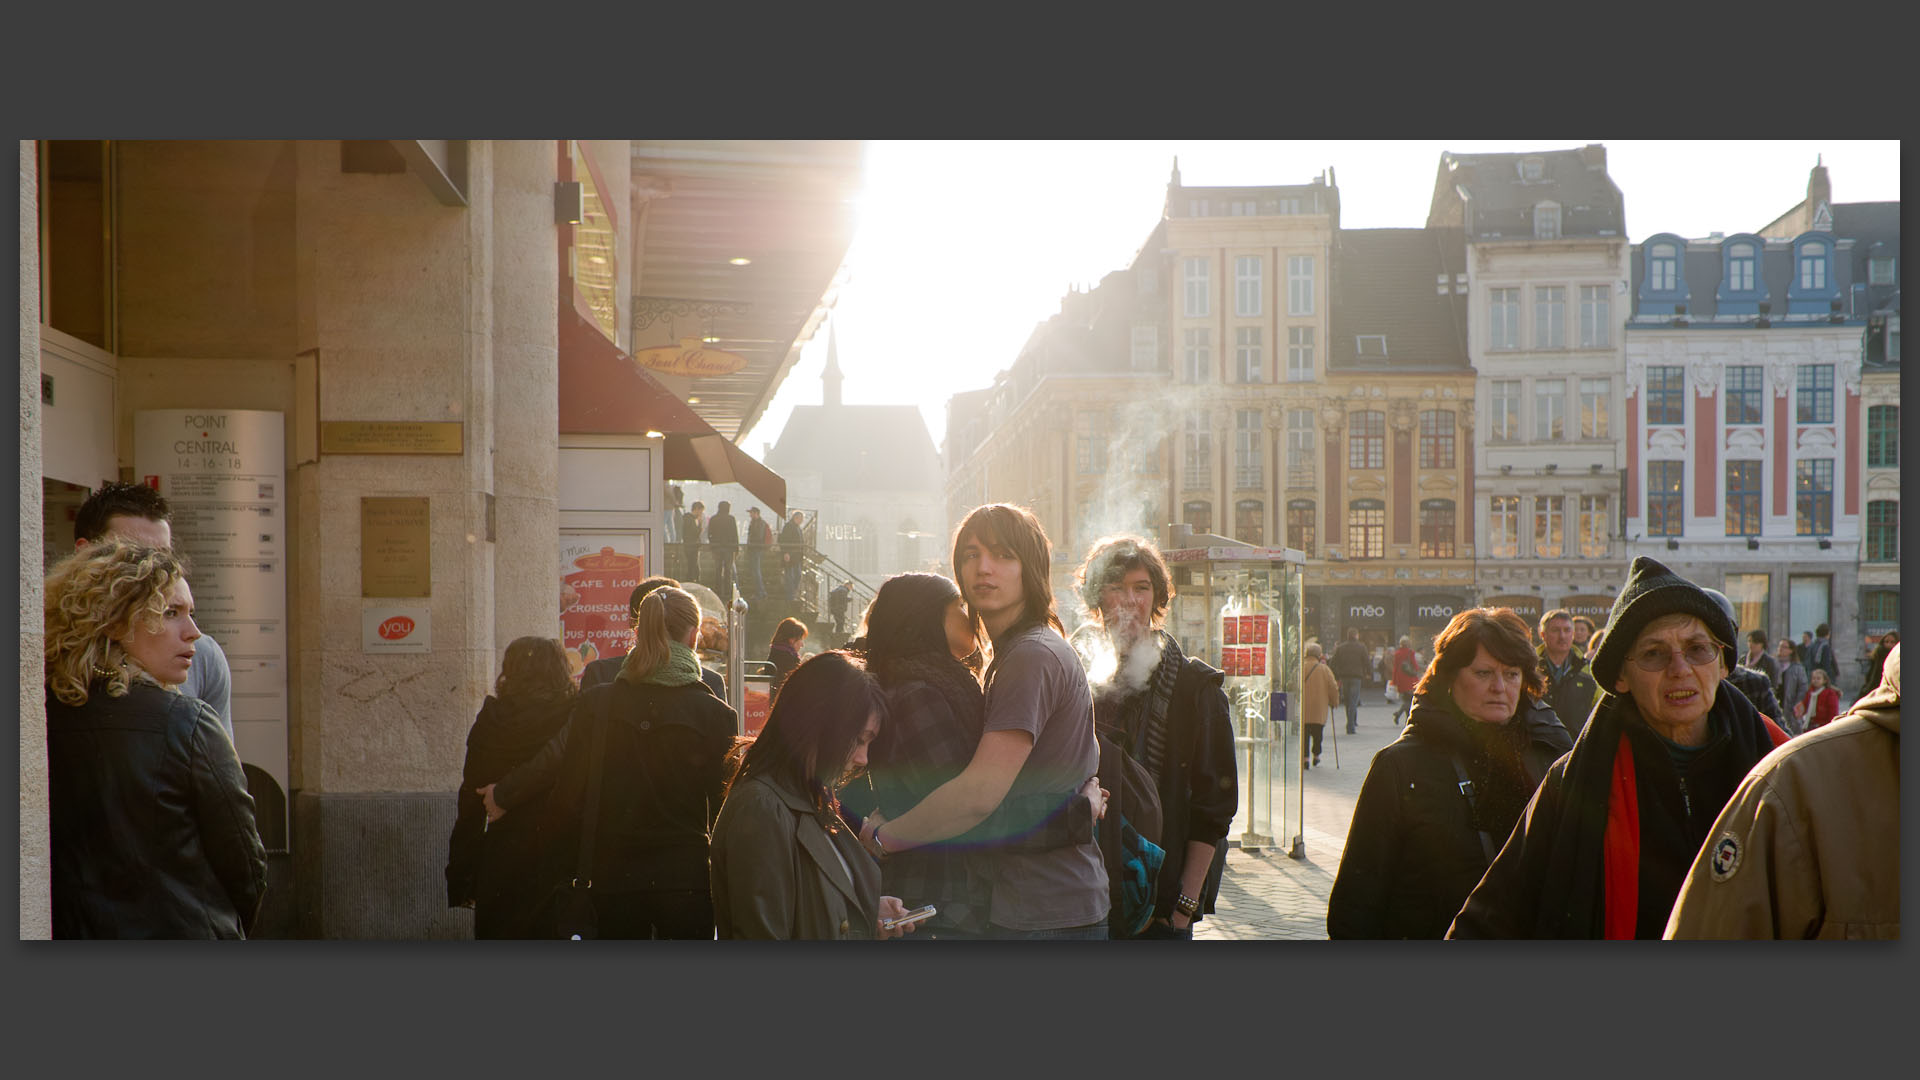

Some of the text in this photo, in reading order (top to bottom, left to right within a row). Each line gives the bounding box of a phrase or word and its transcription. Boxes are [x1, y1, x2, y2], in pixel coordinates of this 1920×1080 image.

[683, 350, 736, 371] Chaud
[184, 415, 227, 429] POINT
[174, 440, 238, 454] CENTRAL
[177, 458, 190, 469] 14
[202, 458, 216, 469] 16
[229, 458, 241, 469] 18
[572, 579, 636, 588] CAFE 1.00
[568, 604, 631, 613] CROISSAN
[383, 622, 411, 637] you
[565, 630, 585, 639] JUS
